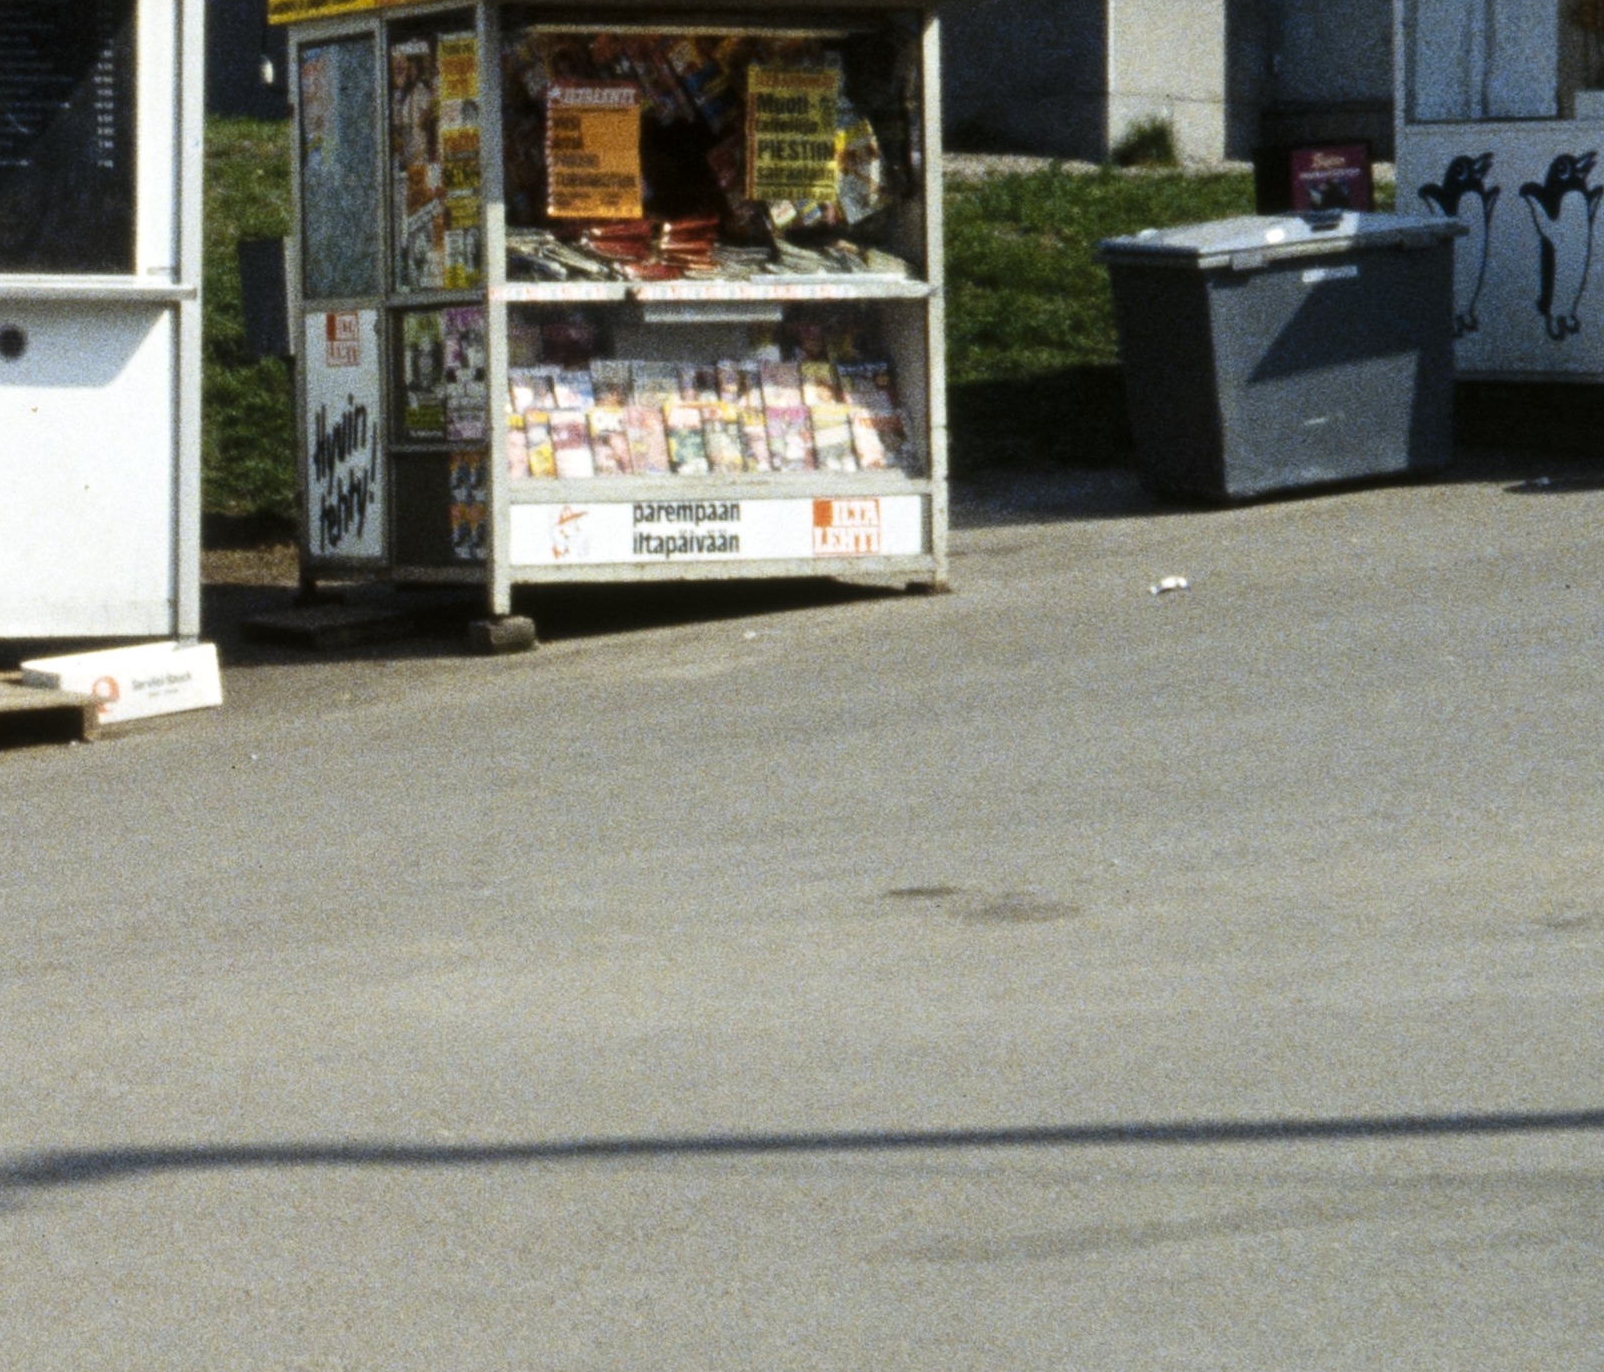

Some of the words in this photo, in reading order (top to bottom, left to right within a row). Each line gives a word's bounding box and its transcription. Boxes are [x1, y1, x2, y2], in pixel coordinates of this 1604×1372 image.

[314, 393, 368, 496] Hyvin
[632, 500, 742, 527] parempaan
[632, 528, 741, 558] iltapäivään
